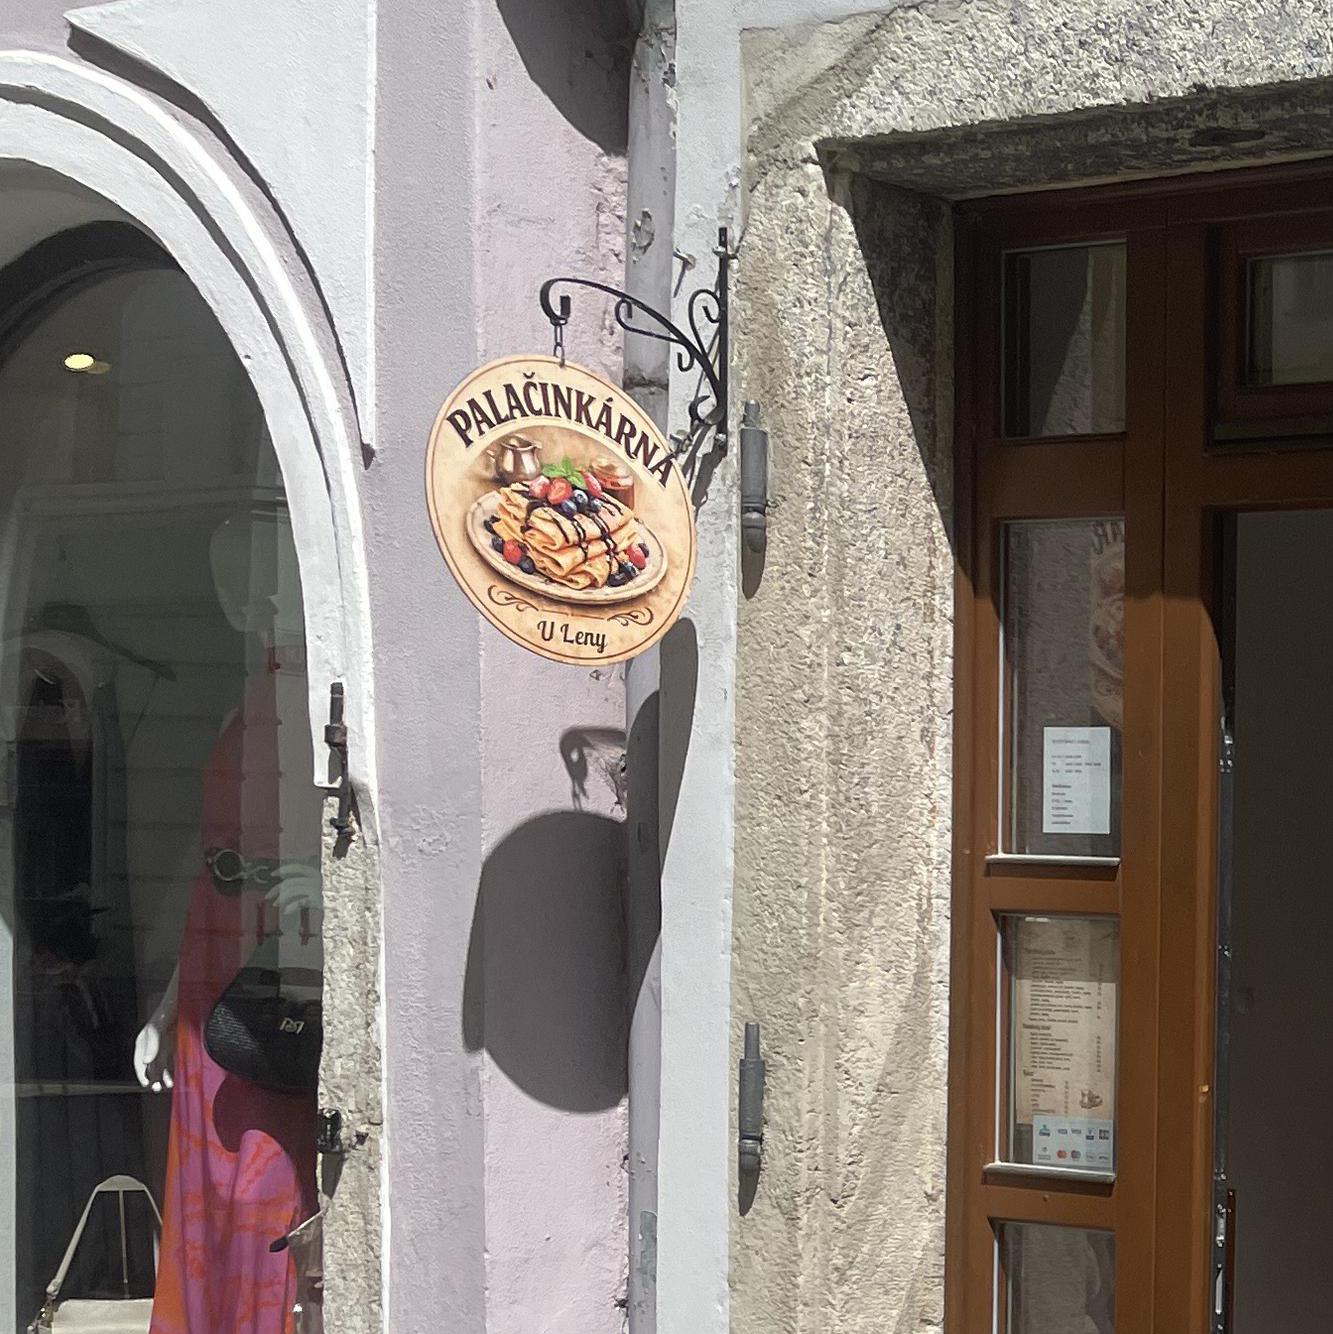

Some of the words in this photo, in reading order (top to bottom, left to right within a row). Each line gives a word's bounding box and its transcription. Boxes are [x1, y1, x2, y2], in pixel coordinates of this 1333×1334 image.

[447, 371, 675, 488] PALAČINKÁRNA
[537, 620, 555, 642] U
[560, 624, 608, 654] Leny
